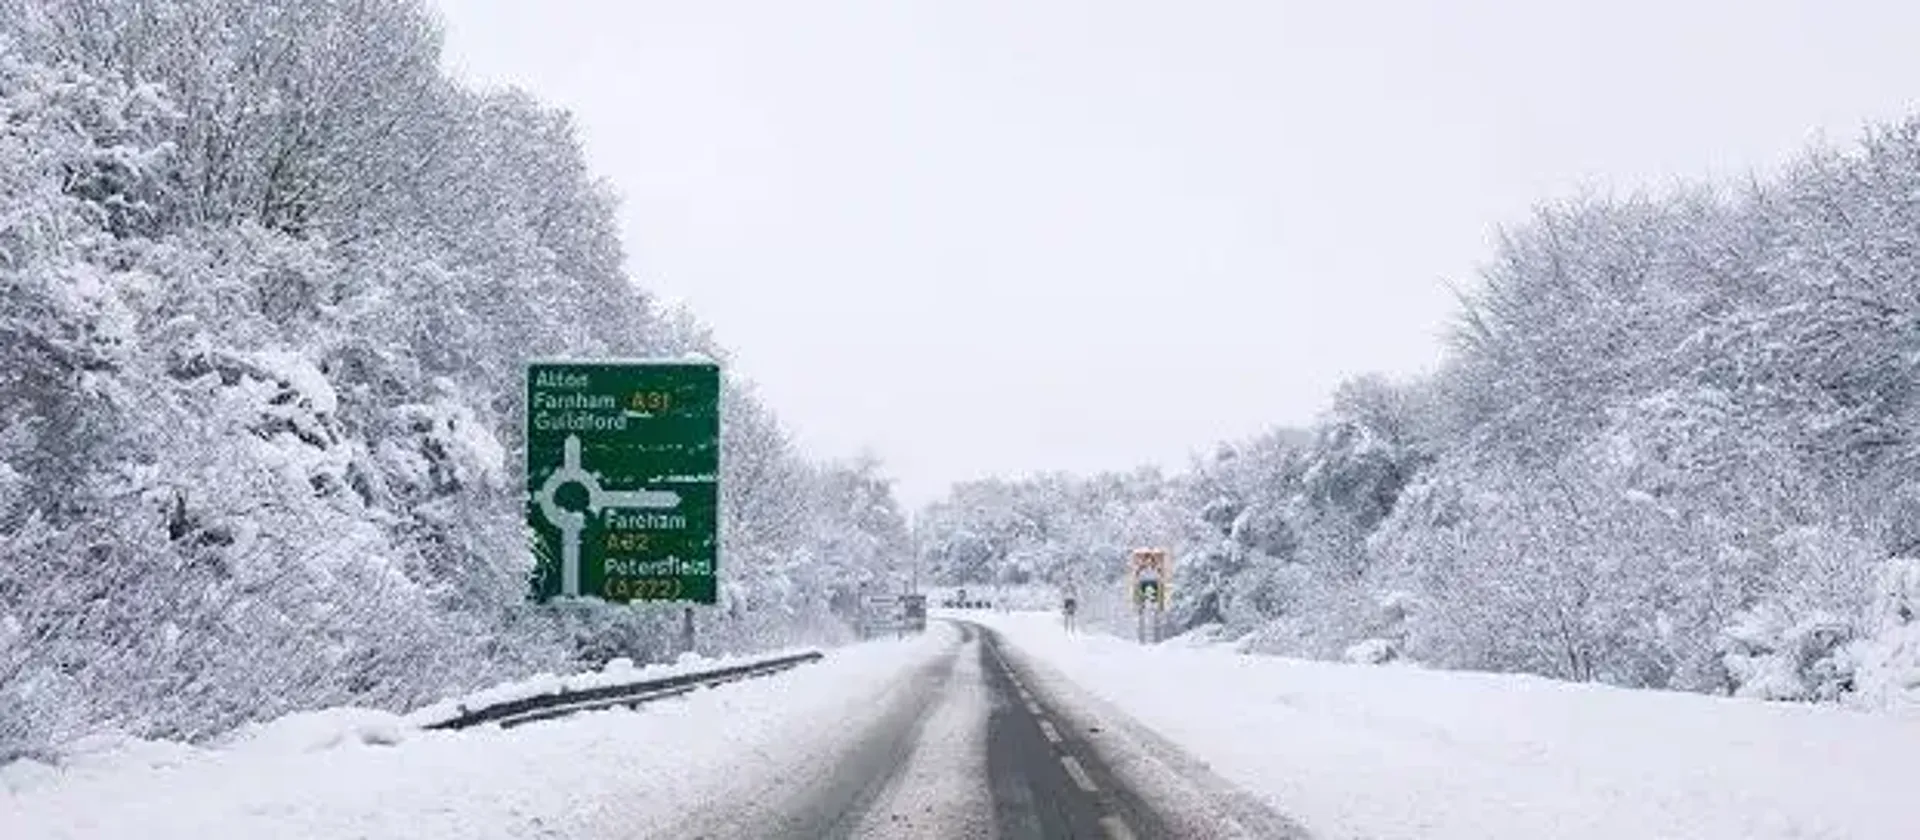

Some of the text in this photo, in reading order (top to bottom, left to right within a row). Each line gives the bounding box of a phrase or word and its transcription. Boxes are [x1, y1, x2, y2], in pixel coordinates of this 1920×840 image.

[536, 370, 588, 387] Alton
[533, 390, 670, 410] Farnham A31
[534, 411, 628, 431] Guildford
[605, 509, 686, 529] Fareham
[604, 555, 711, 576] Petersfield
